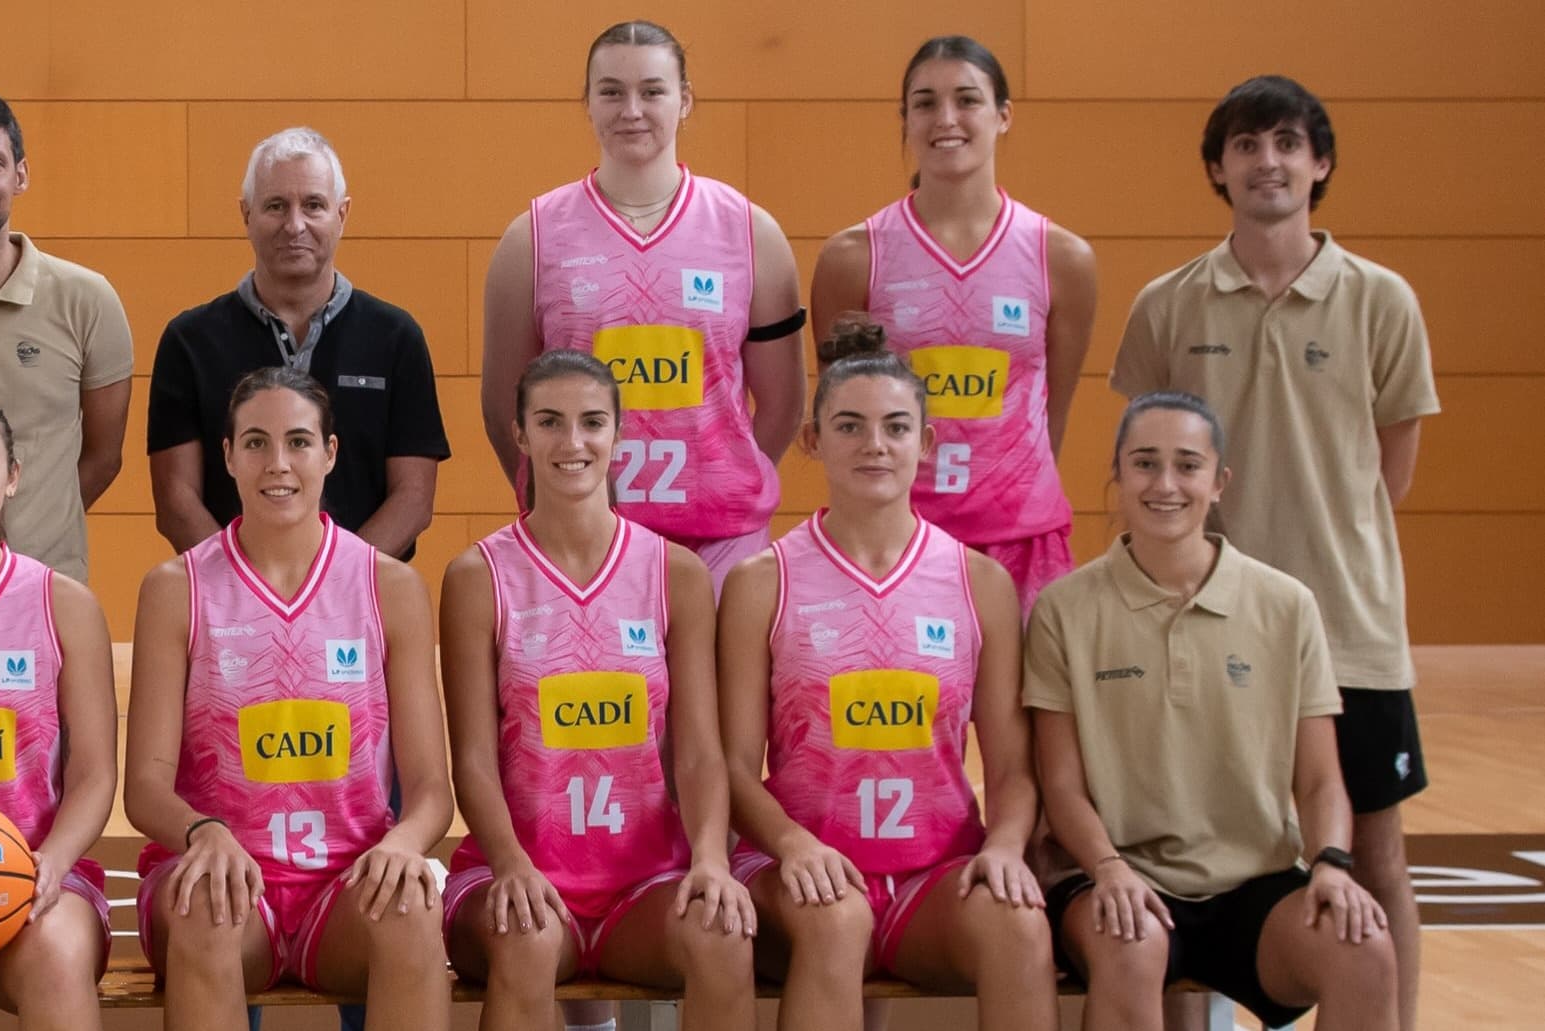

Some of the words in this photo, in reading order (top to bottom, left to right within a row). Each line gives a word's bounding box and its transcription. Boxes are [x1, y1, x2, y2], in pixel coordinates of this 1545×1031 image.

[607, 351, 690, 384] CADÍ
[923, 369, 997, 397] CADÍ
[611, 439, 687, 503] 22
[935, 442, 971, 494] 6
[554, 693, 633, 727] CADÍ
[845, 695, 925, 727] CADÍ
[256, 724, 335, 760] CADÍ
[566, 775, 624, 836] 14
[856, 778, 914, 838] 12
[266, 811, 329, 868] 13
